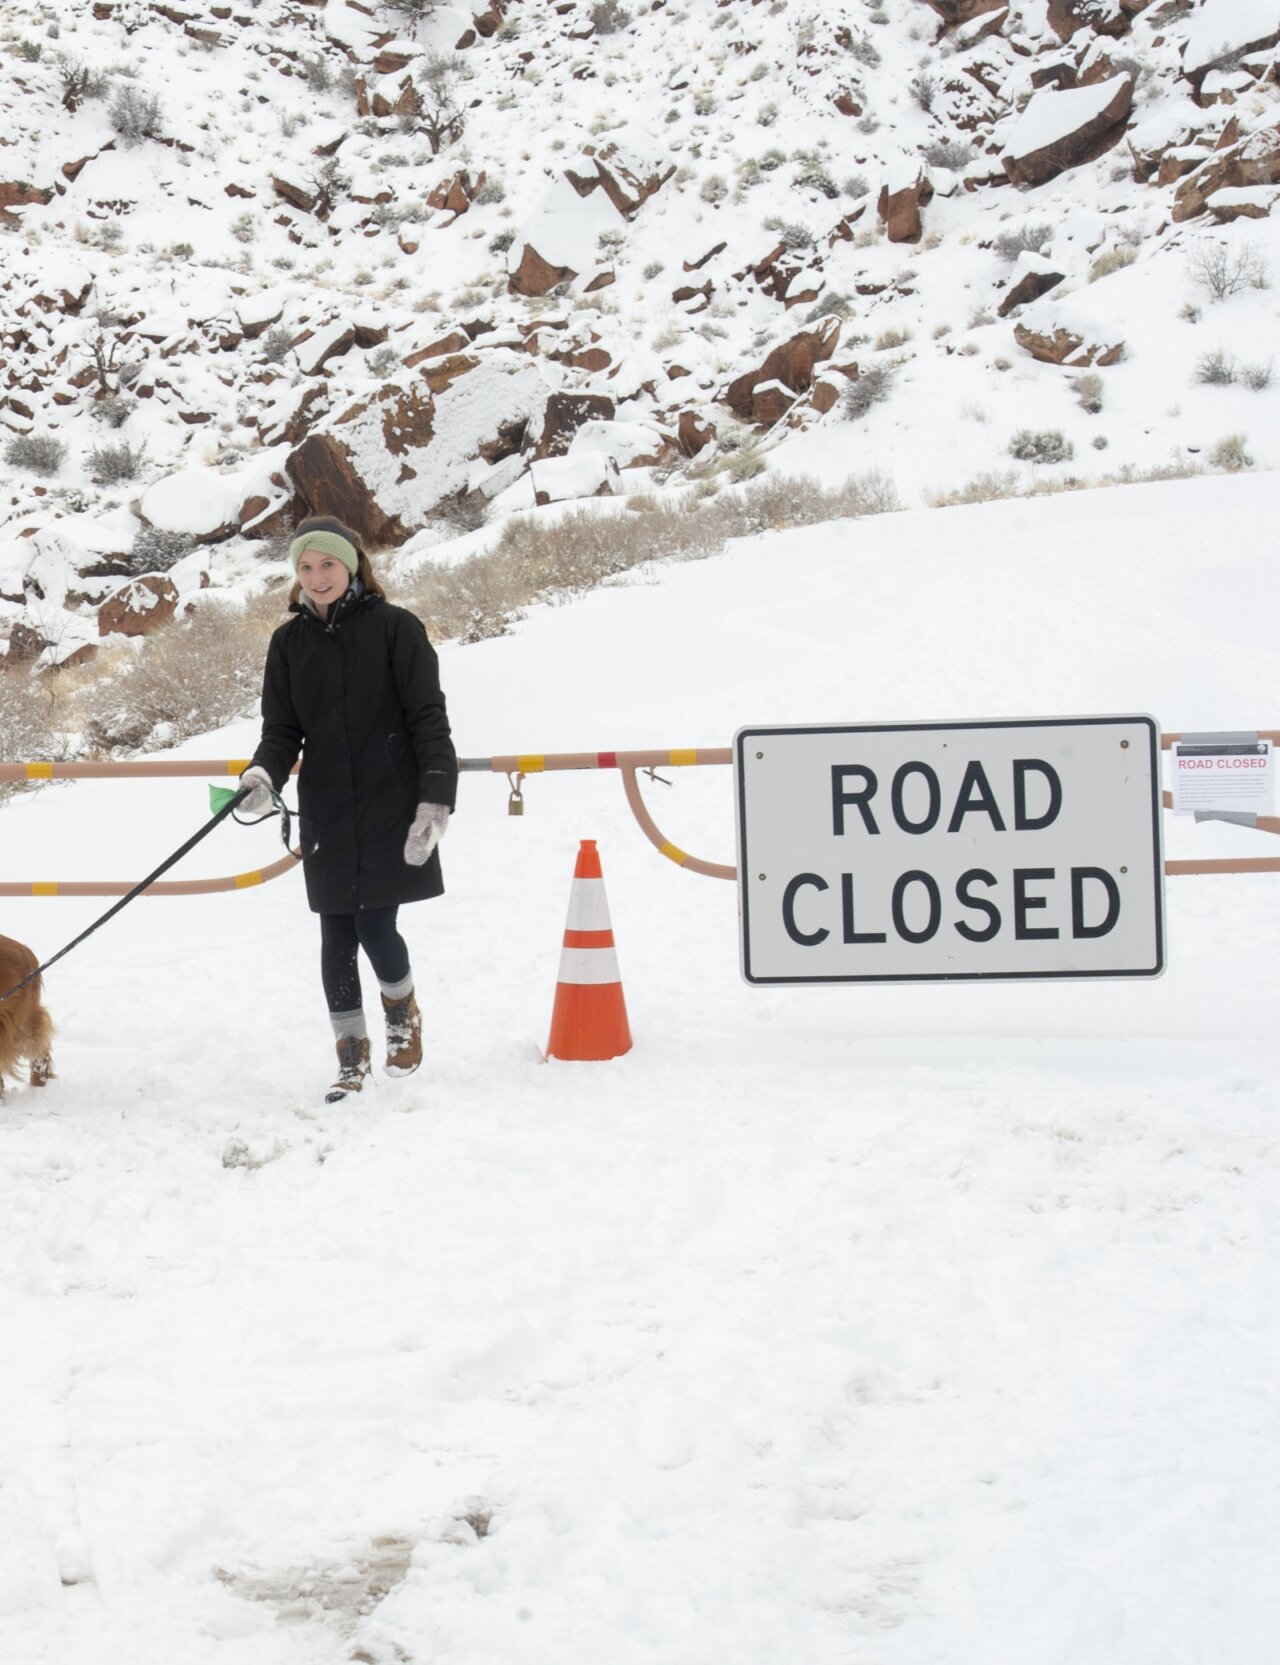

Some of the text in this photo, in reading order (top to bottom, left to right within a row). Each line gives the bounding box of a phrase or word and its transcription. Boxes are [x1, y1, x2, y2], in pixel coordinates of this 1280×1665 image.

[830, 758, 1064, 837] ROAD
[1179, 758, 1267, 769] ROAD CLOSED
[781, 866, 1121, 947] CLOSED
